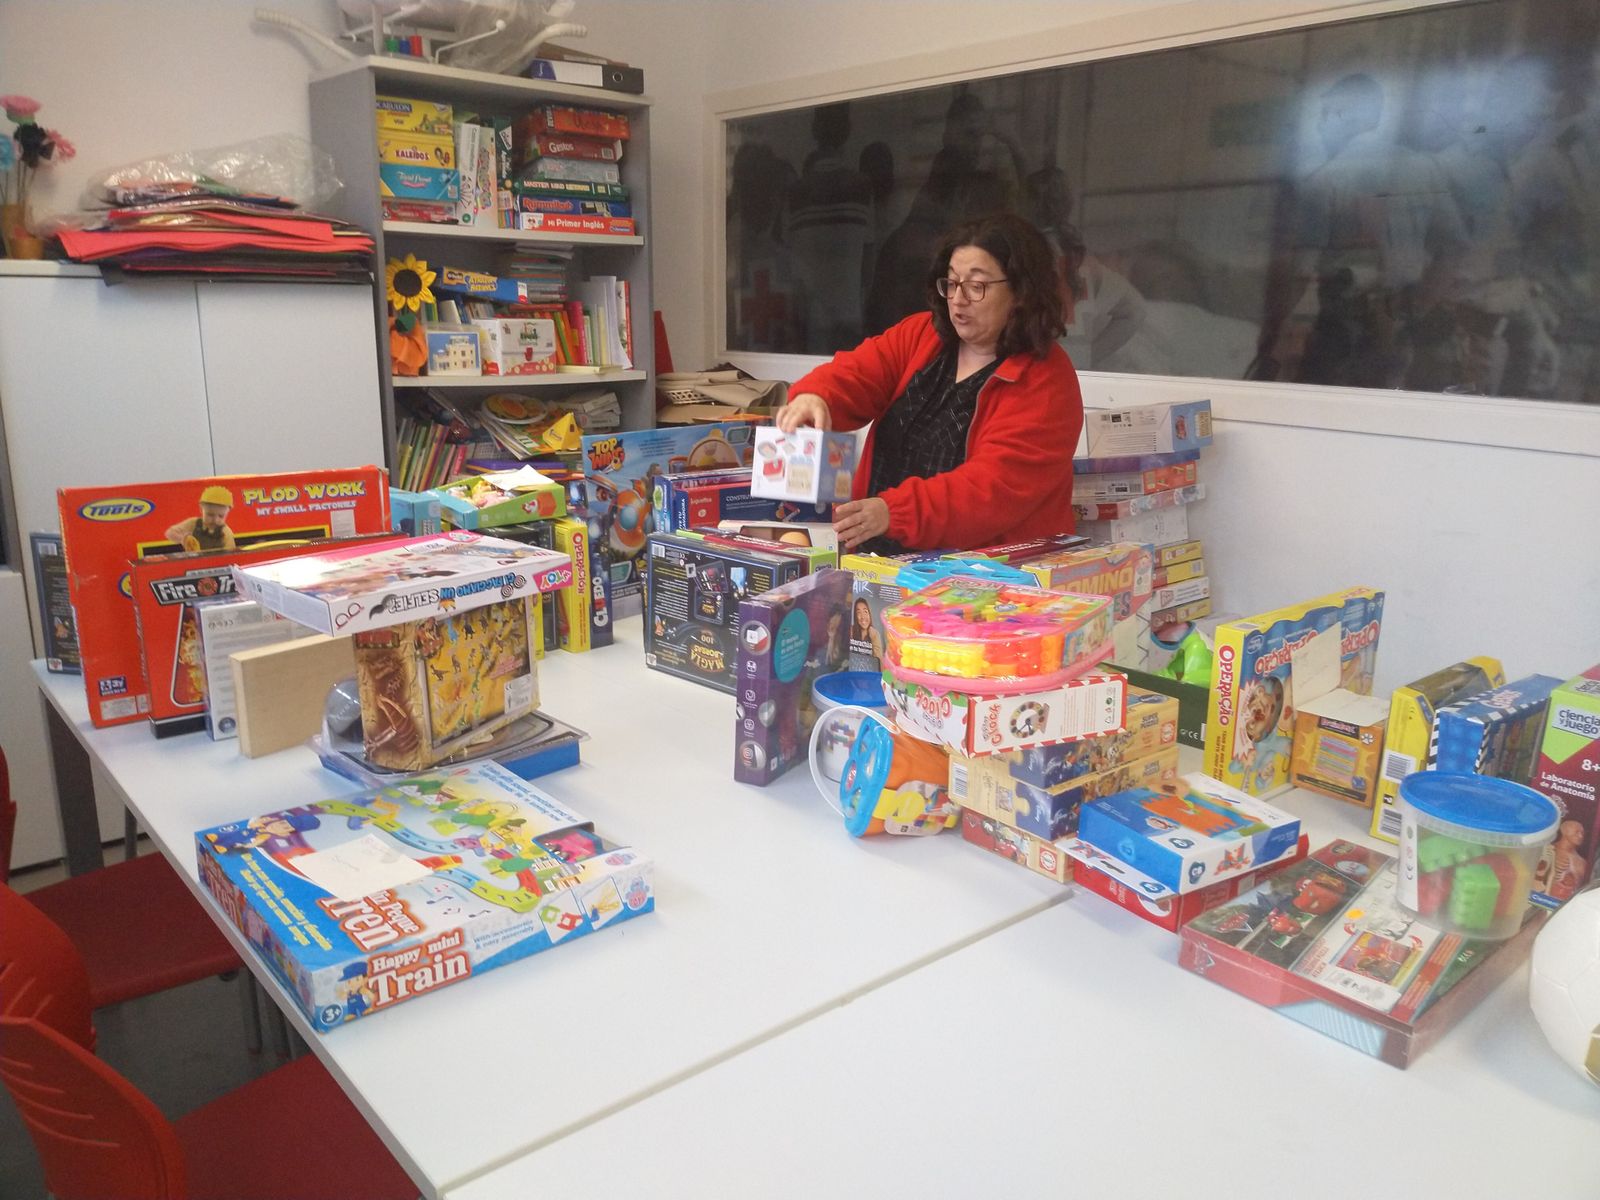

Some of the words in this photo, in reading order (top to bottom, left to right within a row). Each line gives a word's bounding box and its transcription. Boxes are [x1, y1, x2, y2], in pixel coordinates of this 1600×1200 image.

[556, 218, 581, 229] Primer
[583, 219, 605, 231] Inglés
[592, 438, 618, 453] TOP
[242, 487, 299, 505] PLOD
[305, 481, 366, 500] WORK
[89, 501, 145, 517] Tools
[256, 507, 271, 517] MY
[273, 504, 306, 515] SMALL
[572, 531, 586, 597] OPERACIÓN
[158, 580, 198, 601] Fire
[592, 576, 609, 627] CLUEDO
[1218, 645, 1236, 727] OPERAÇÃO
[1565, 717, 1599, 735] juego
[1541, 772, 1596, 793] Laboratorio
[1550, 782, 1596, 801] Anatomía
[385, 899, 419, 934] Peque
[372, 945, 421, 972] Happy
[428, 932, 461, 959] mini
[369, 953, 469, 1005] Train
